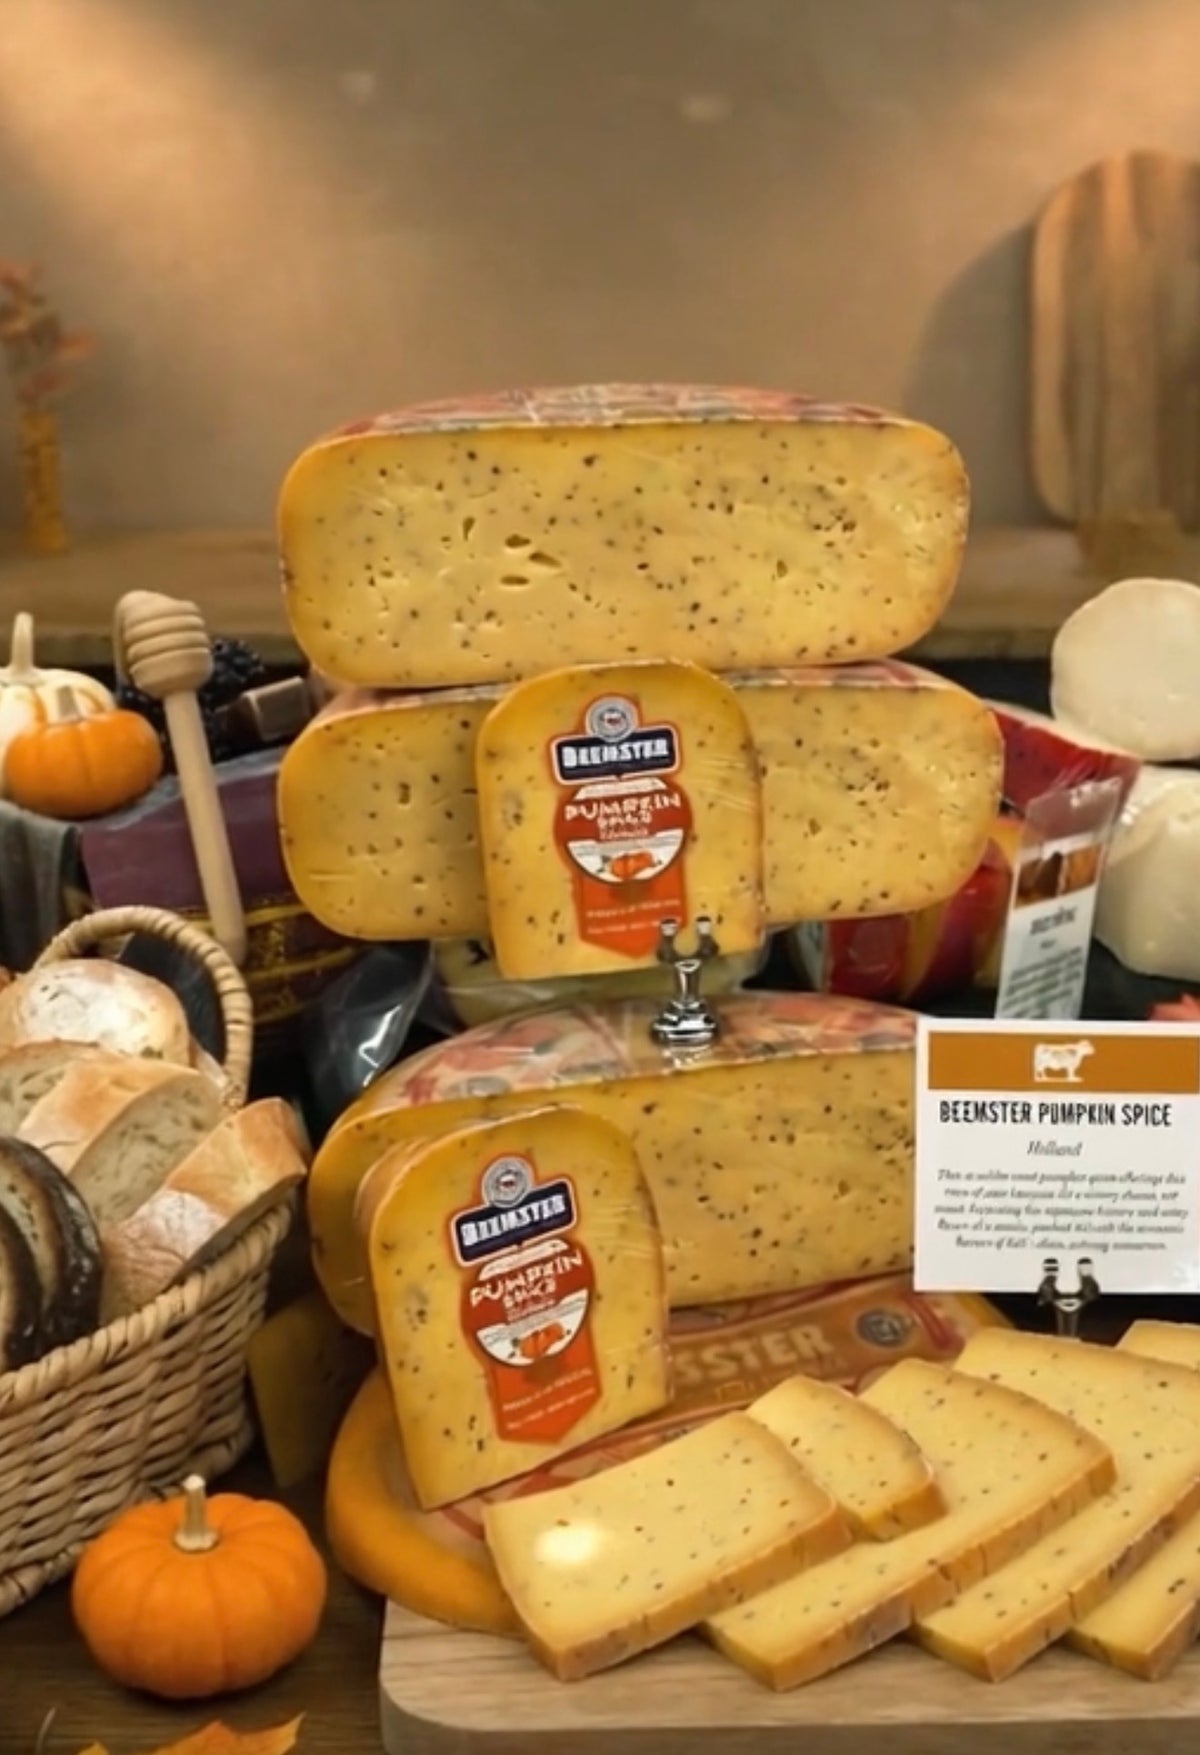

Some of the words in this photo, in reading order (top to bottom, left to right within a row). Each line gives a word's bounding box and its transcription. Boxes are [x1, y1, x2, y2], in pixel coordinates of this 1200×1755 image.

[562, 738, 669, 768] BEEMSTER
[564, 792, 682, 822] PUMPKIN
[939, 1100, 1032, 1124] BEEMSTER
[1038, 1102, 1116, 1126] PUMPKIN
[1121, 1103, 1173, 1127] SPICE
[1027, 1140, 1083, 1157] Holland
[460, 1193, 566, 1247] BEEMSTER
[470, 1248, 584, 1308] PUMPKIN
